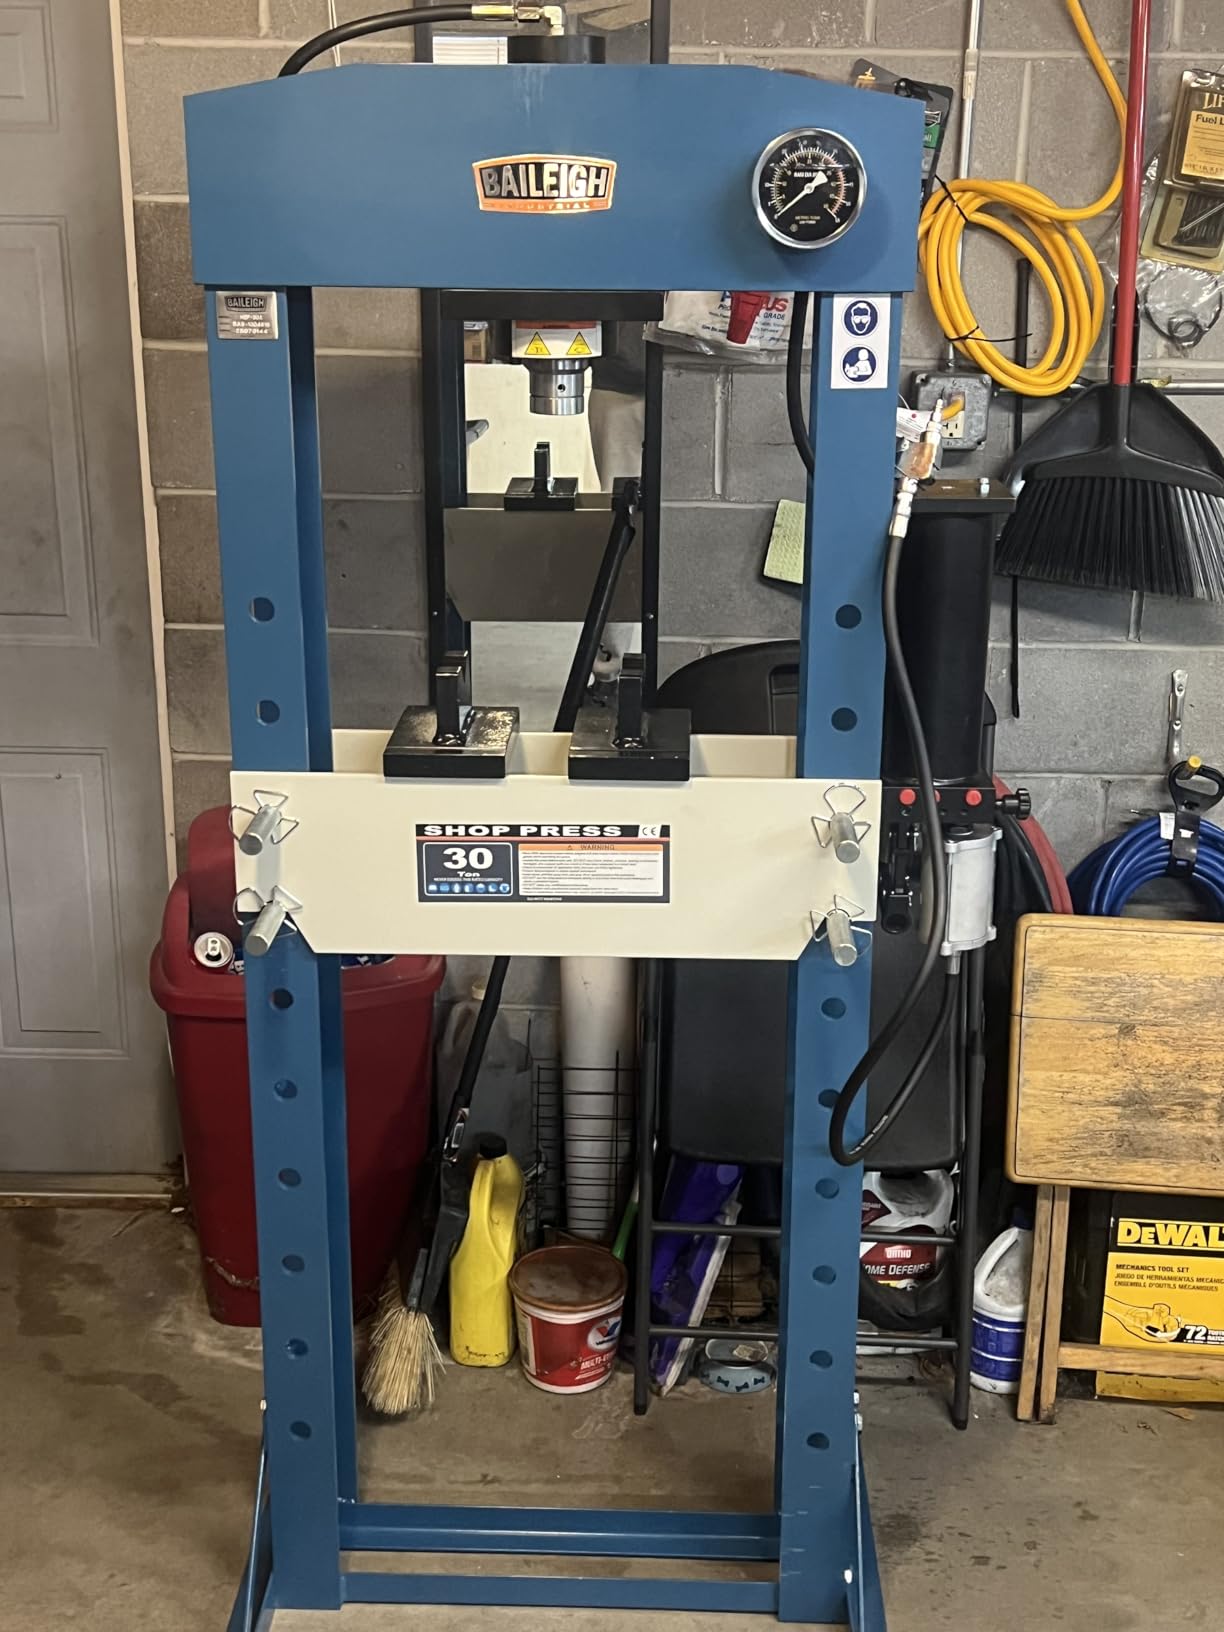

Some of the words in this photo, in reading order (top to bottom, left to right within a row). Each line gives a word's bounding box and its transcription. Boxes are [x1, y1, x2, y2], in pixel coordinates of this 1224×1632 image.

[1195, 113, 1217, 124] Fuel
[481, 163, 607, 198] BAILEIGH
[227, 297, 264, 308] BAILEIGH
[761, 296, 789, 312] US
[763, 312, 785, 321] GRADE
[424, 825, 510, 836] SHOP
[519, 825, 622, 837] PRESS
[442, 847, 494, 870] 30
[864, 1264, 886, 1275] OME
[1115, 1263, 1156, 1272] MECHANICS
[1184, 1325, 1207, 1340] 72
